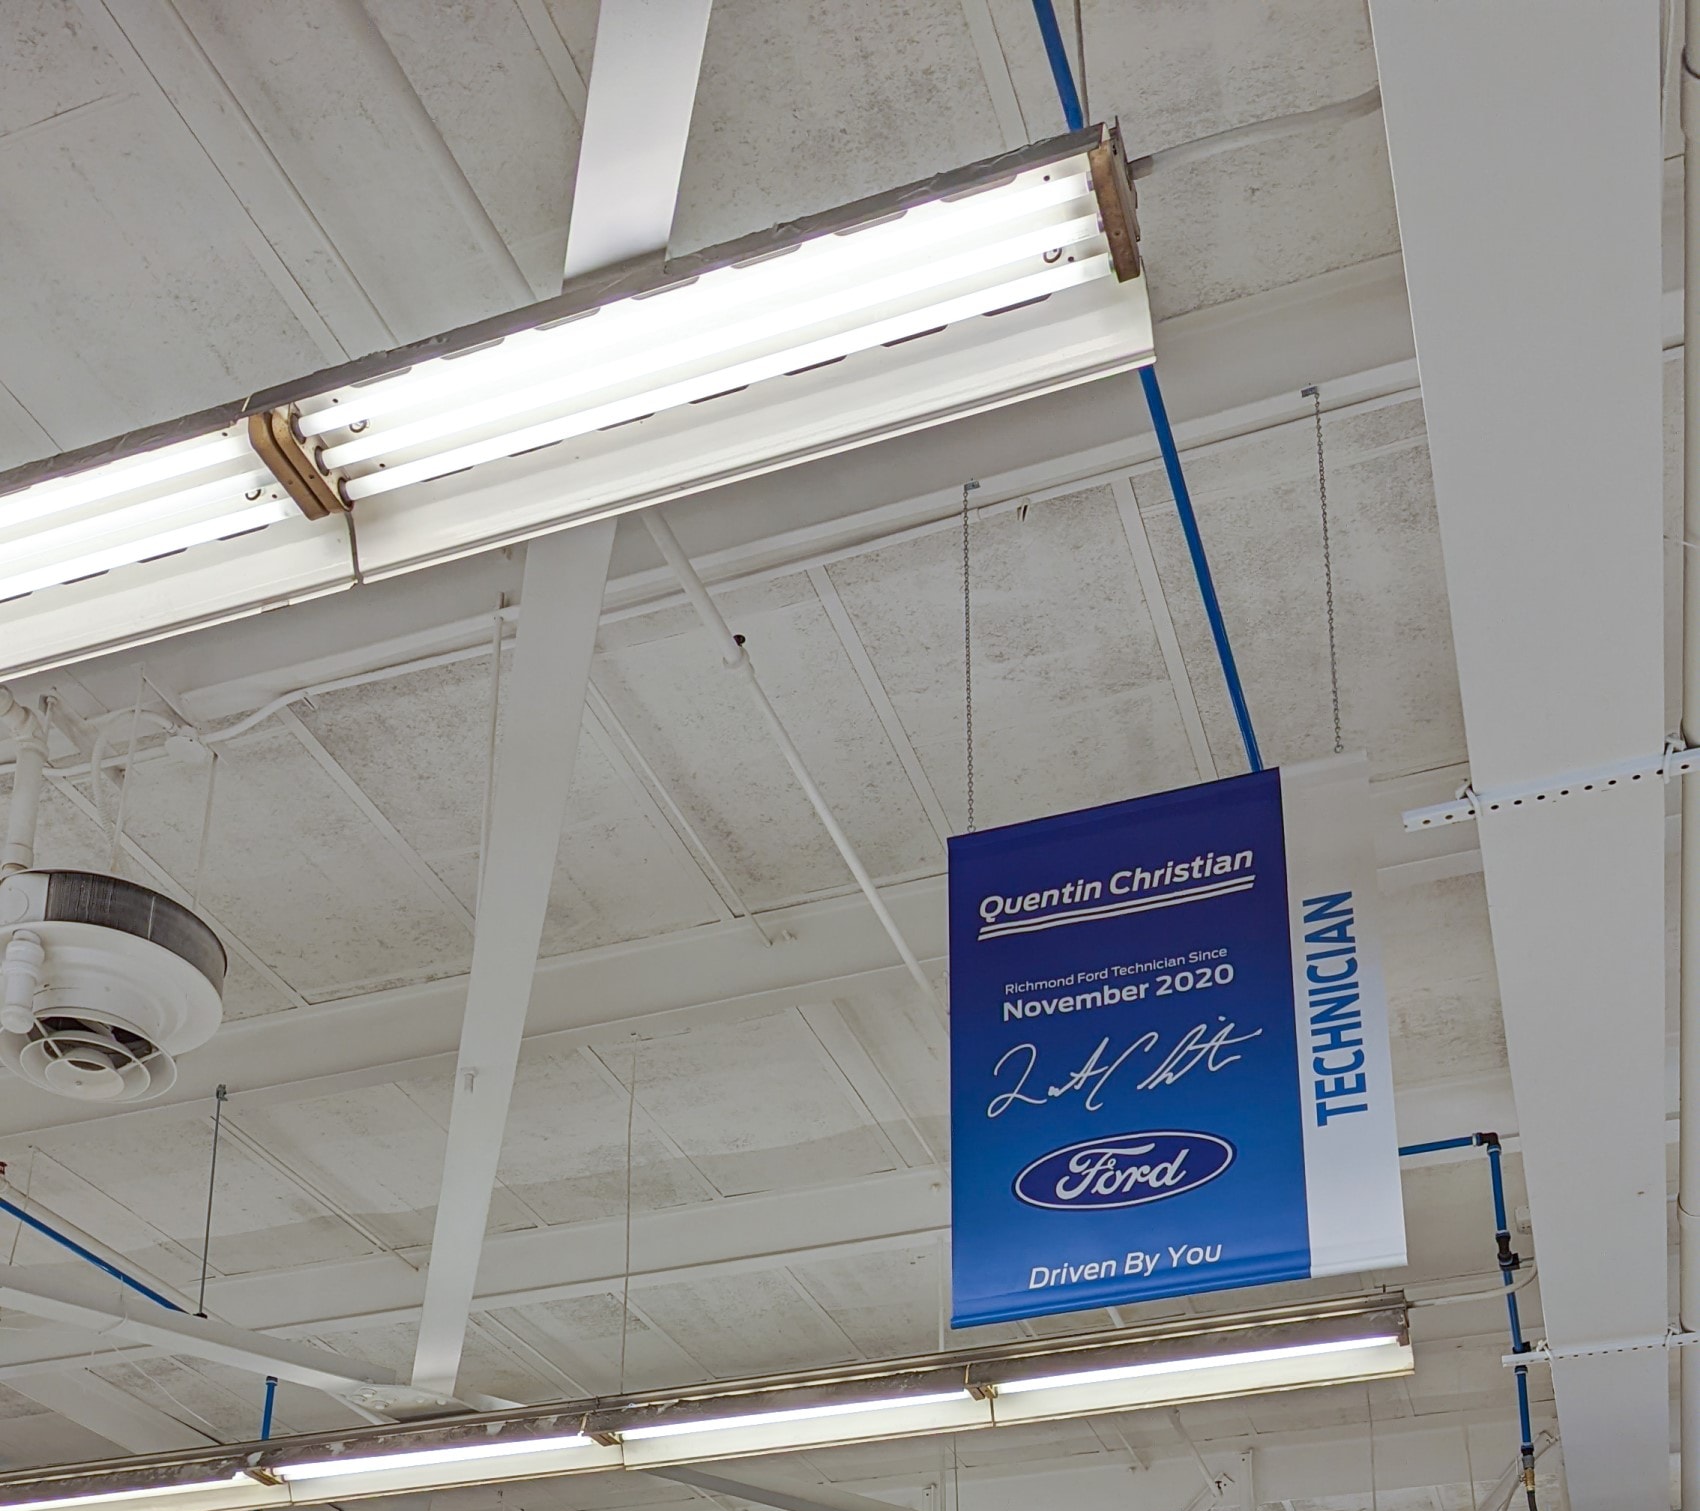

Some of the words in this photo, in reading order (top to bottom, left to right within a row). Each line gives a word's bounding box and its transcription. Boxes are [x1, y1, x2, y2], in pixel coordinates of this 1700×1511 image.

[979, 878, 1102, 923] Quentin
[1109, 849, 1253, 895] Christian
[1003, 983, 1149, 1022] November
[1155, 963, 1234, 997] 2020
[1005, 973, 1074, 995] Richmond
[1077, 968, 1108, 983] Ford
[1111, 956, 1186, 977] Technician
[1188, 948, 1228, 964] Since
[1302, 891, 1368, 1127] TECHNICIAN
[1055, 1142, 1190, 1200] Ford
[1028, 1258, 1117, 1290] Driven
[1124, 1251, 1160, 1277] By
[1167, 1244, 1223, 1269] You
